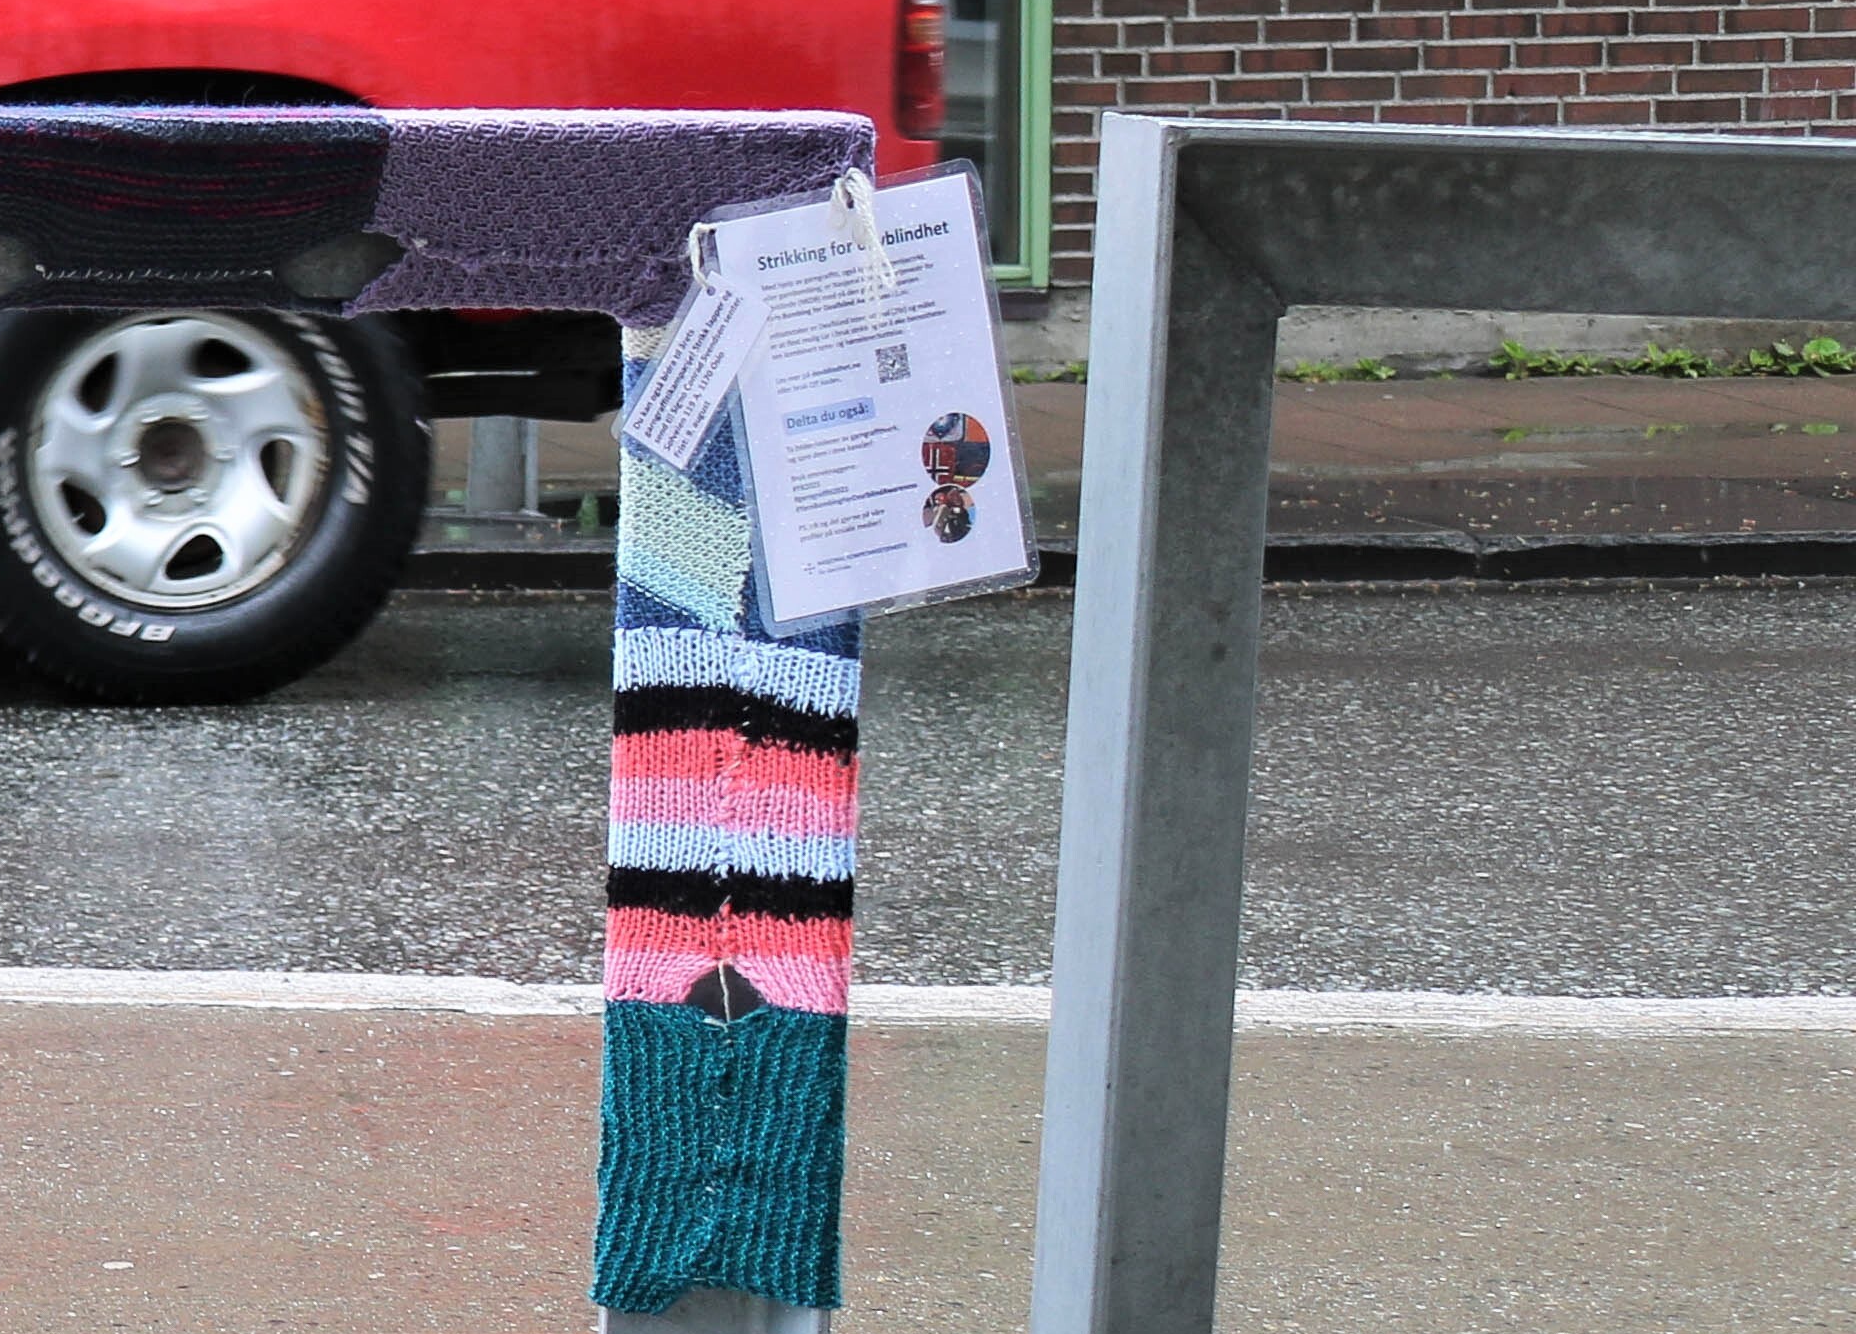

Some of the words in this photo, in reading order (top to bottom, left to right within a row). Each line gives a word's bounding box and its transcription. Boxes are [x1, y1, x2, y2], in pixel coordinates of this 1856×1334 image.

[758, 248, 826, 270] Strikking
[830, 240, 852, 256] for
[693, 329, 708, 349] Strikk
[706, 302, 723, 327] lapper
[633, 418, 643, 429] Du
[641, 402, 652, 416] kan
[651, 383, 663, 401] også
[661, 361, 676, 381] bidra
[674, 350, 682, 359] til
[679, 330, 694, 349] årets
[655, 423, 668, 443] send
[665, 413, 674, 423] til
[684, 362, 704, 391] Conrad
[701, 325, 726, 362] Svendsen
[699, 370, 713, 390] 1170
[711, 352, 724, 369] Oslo
[693, 401, 710, 428] august
[787, 415, 818, 428] Delta
[821, 411, 835, 421] du
[839, 403, 868, 419] også:
